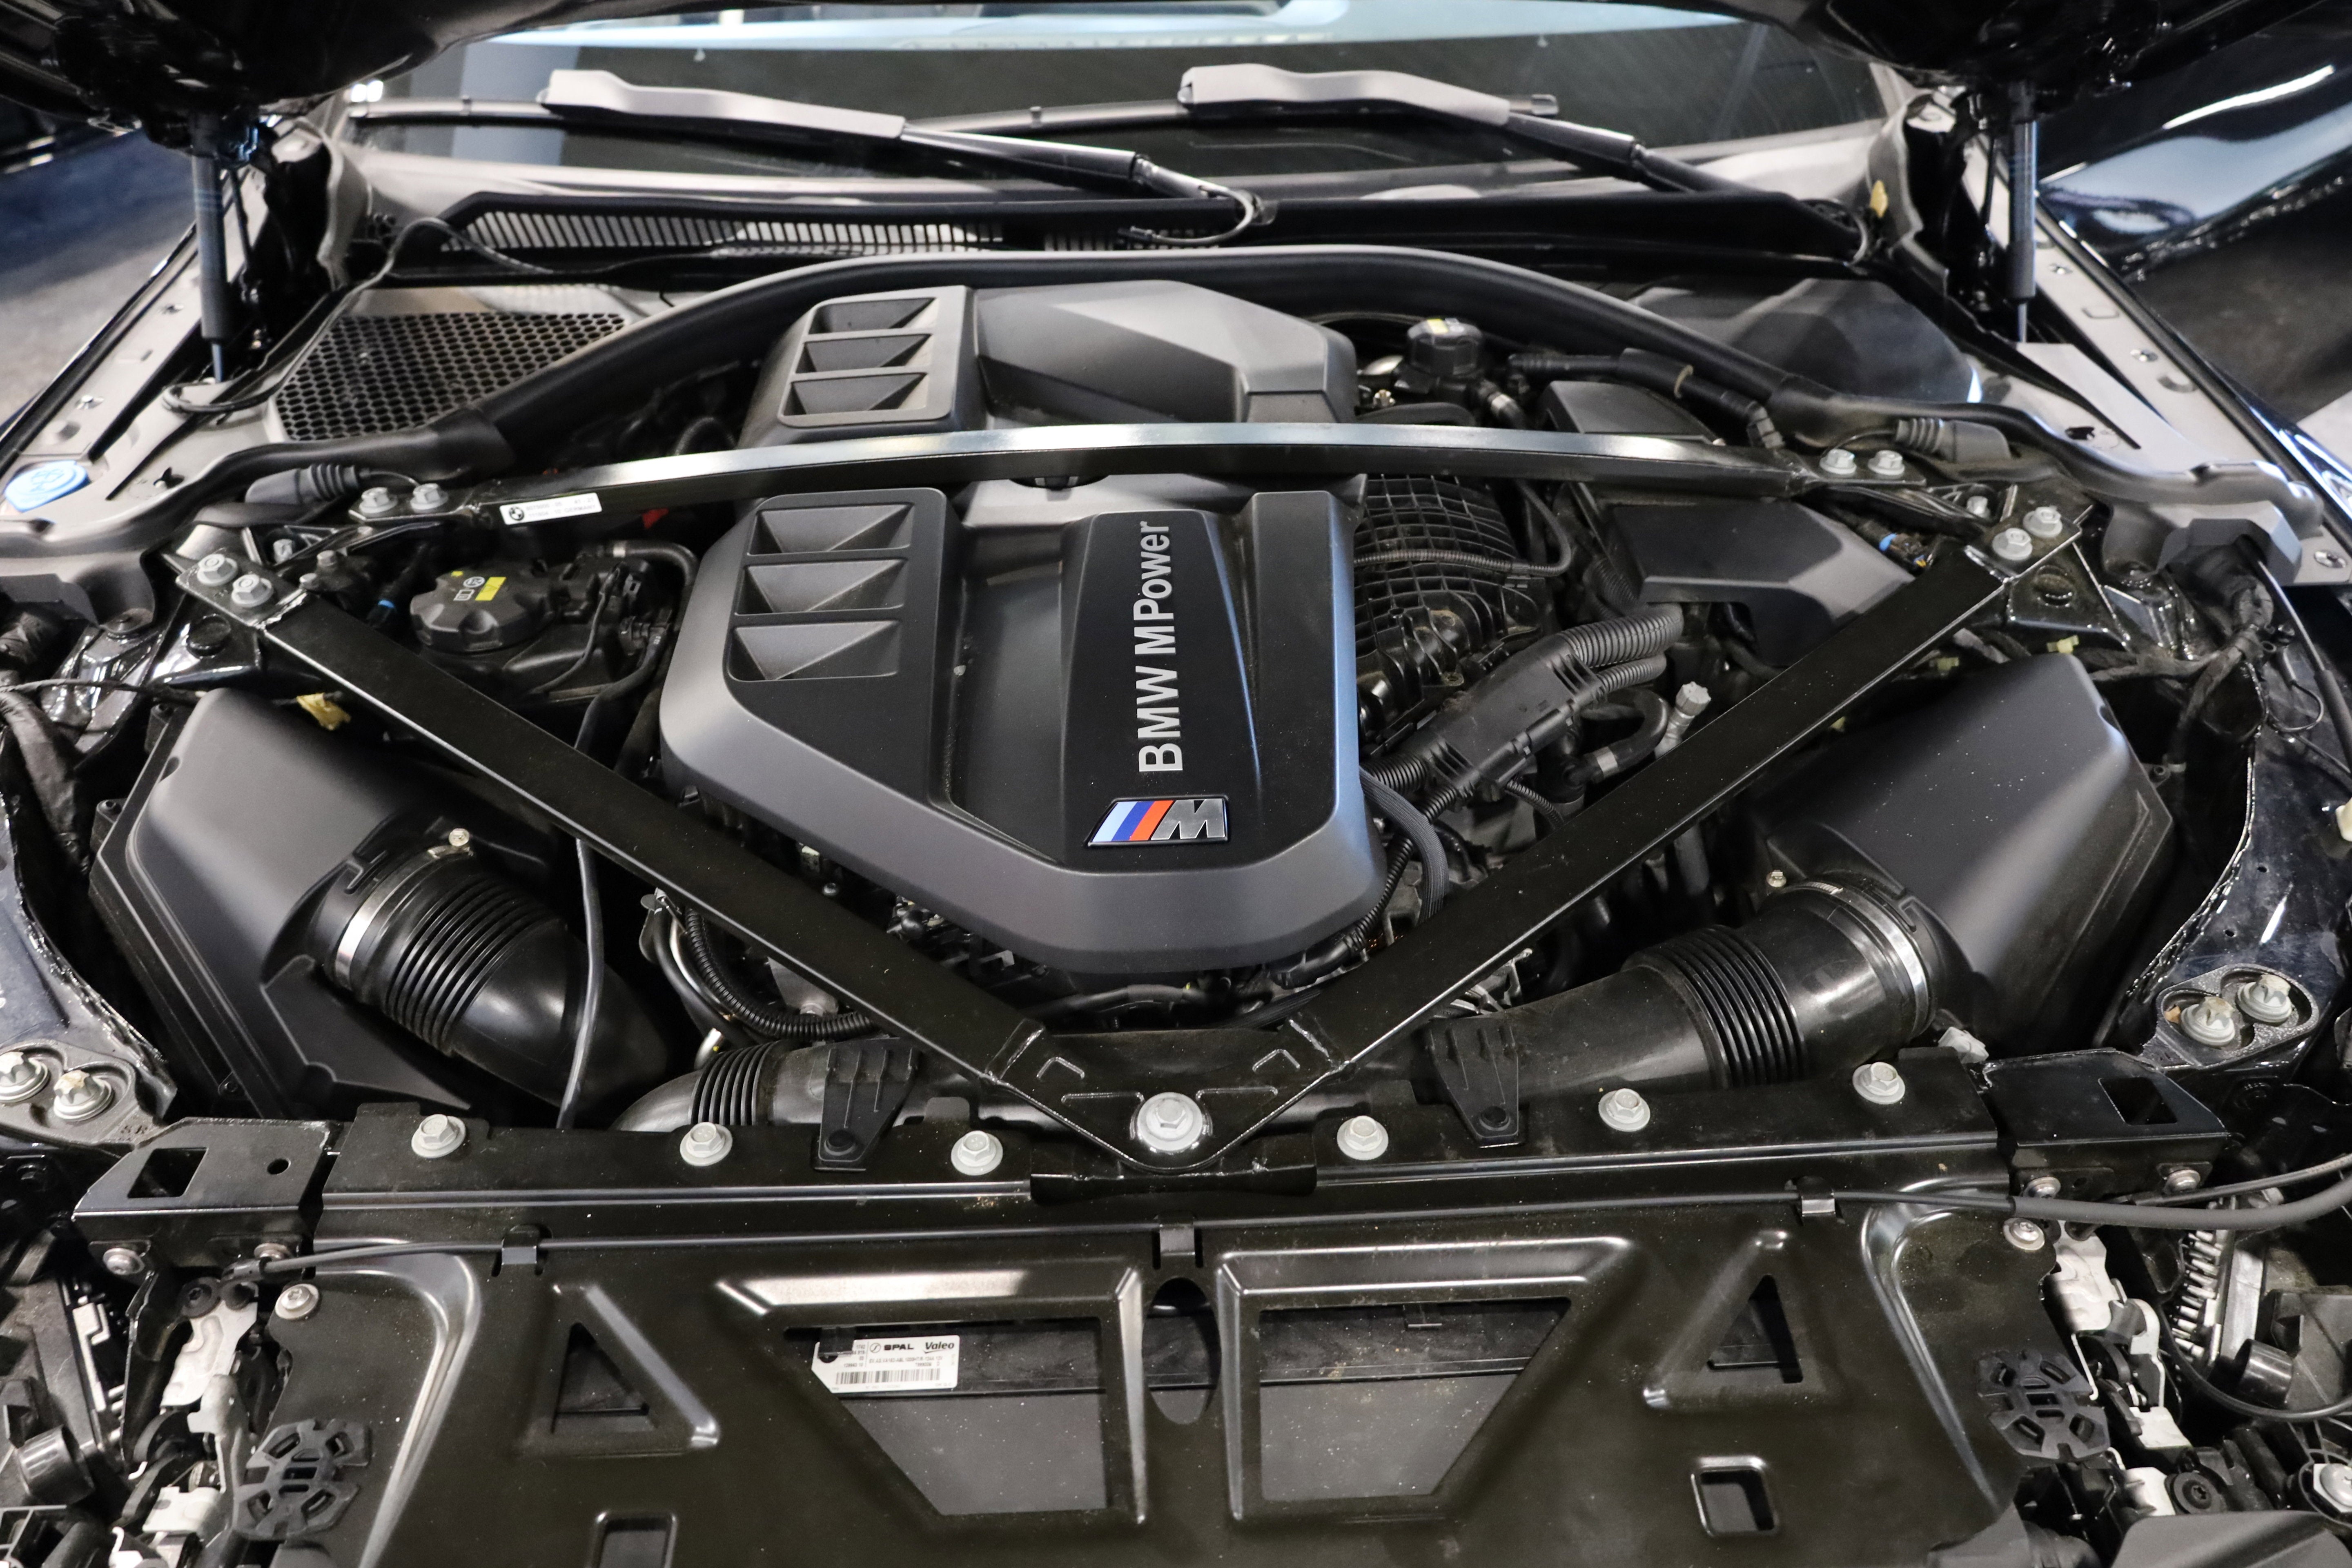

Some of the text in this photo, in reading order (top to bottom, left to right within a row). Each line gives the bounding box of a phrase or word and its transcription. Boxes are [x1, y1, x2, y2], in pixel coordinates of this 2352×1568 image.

[564, 504, 595, 513] GERMANY
[1133, 521, 1183, 773] BMW MPower
[925, 1341, 955, 1350] Valeo
